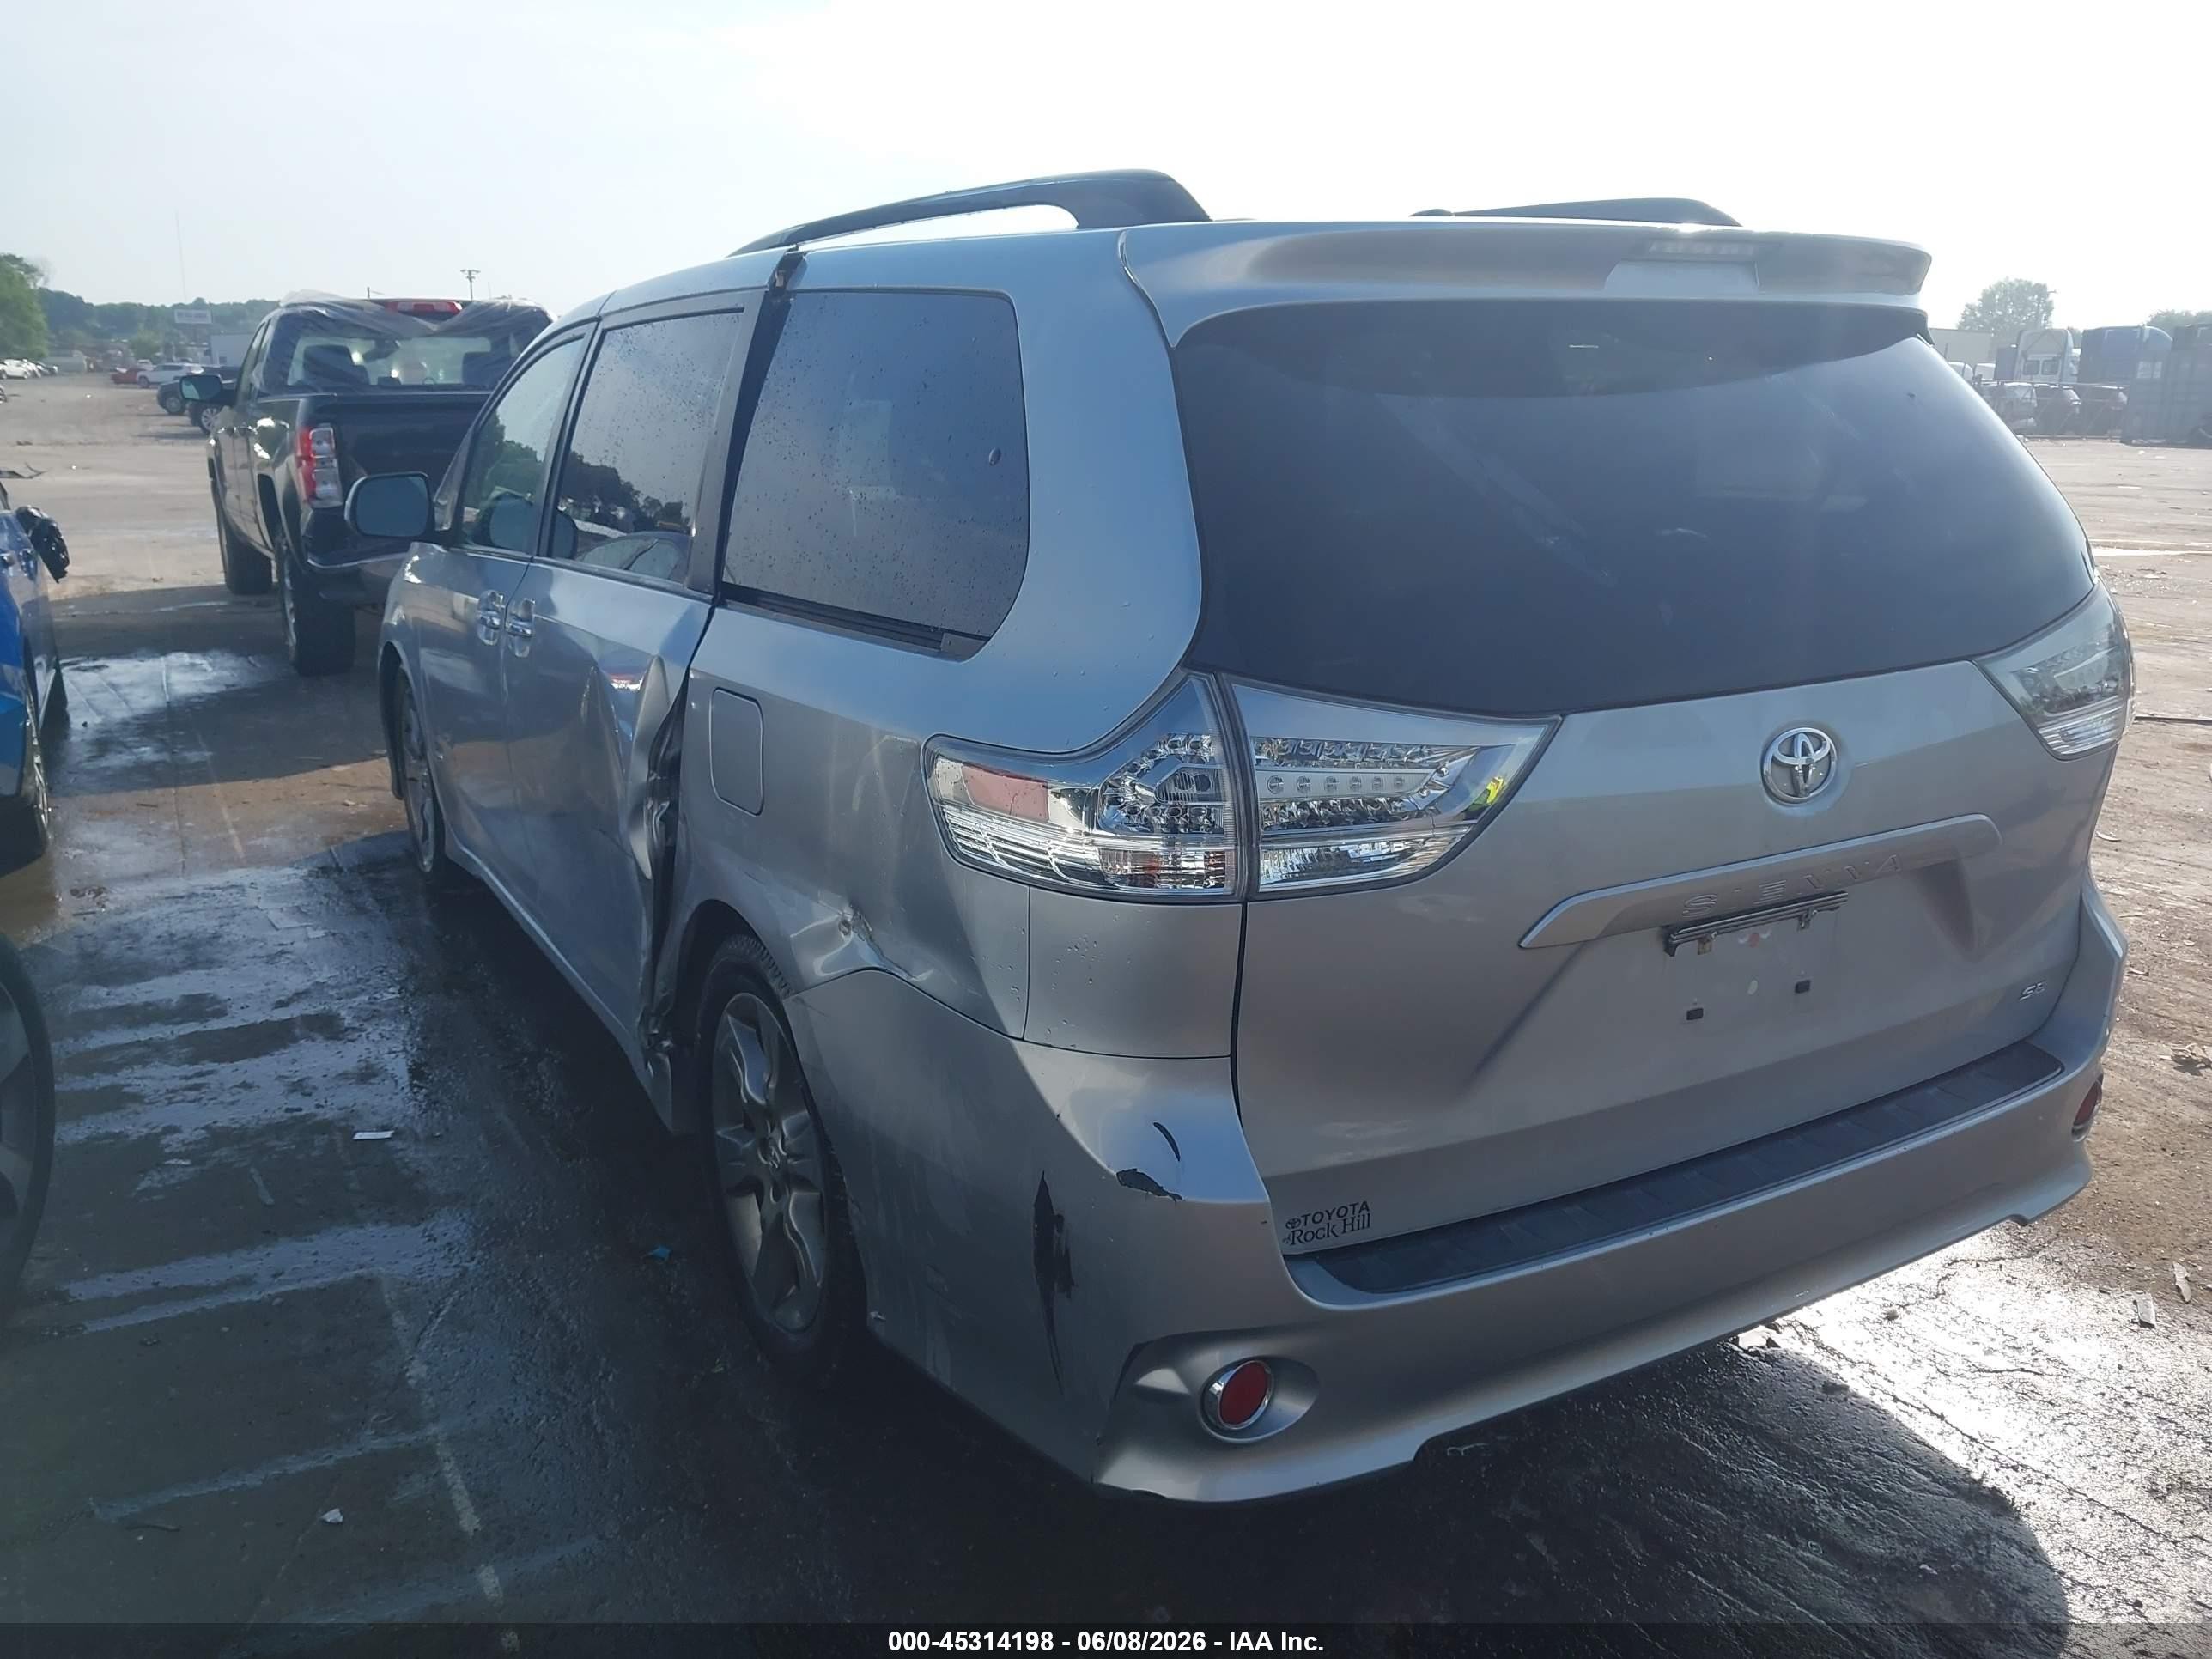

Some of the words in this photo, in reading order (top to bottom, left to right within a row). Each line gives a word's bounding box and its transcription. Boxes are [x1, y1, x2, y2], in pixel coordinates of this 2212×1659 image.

[1301, 1200, 1370, 1226] TOYOTA
[1291, 1222, 1339, 1246] Rock
[1341, 1212, 1371, 1235] Hill
